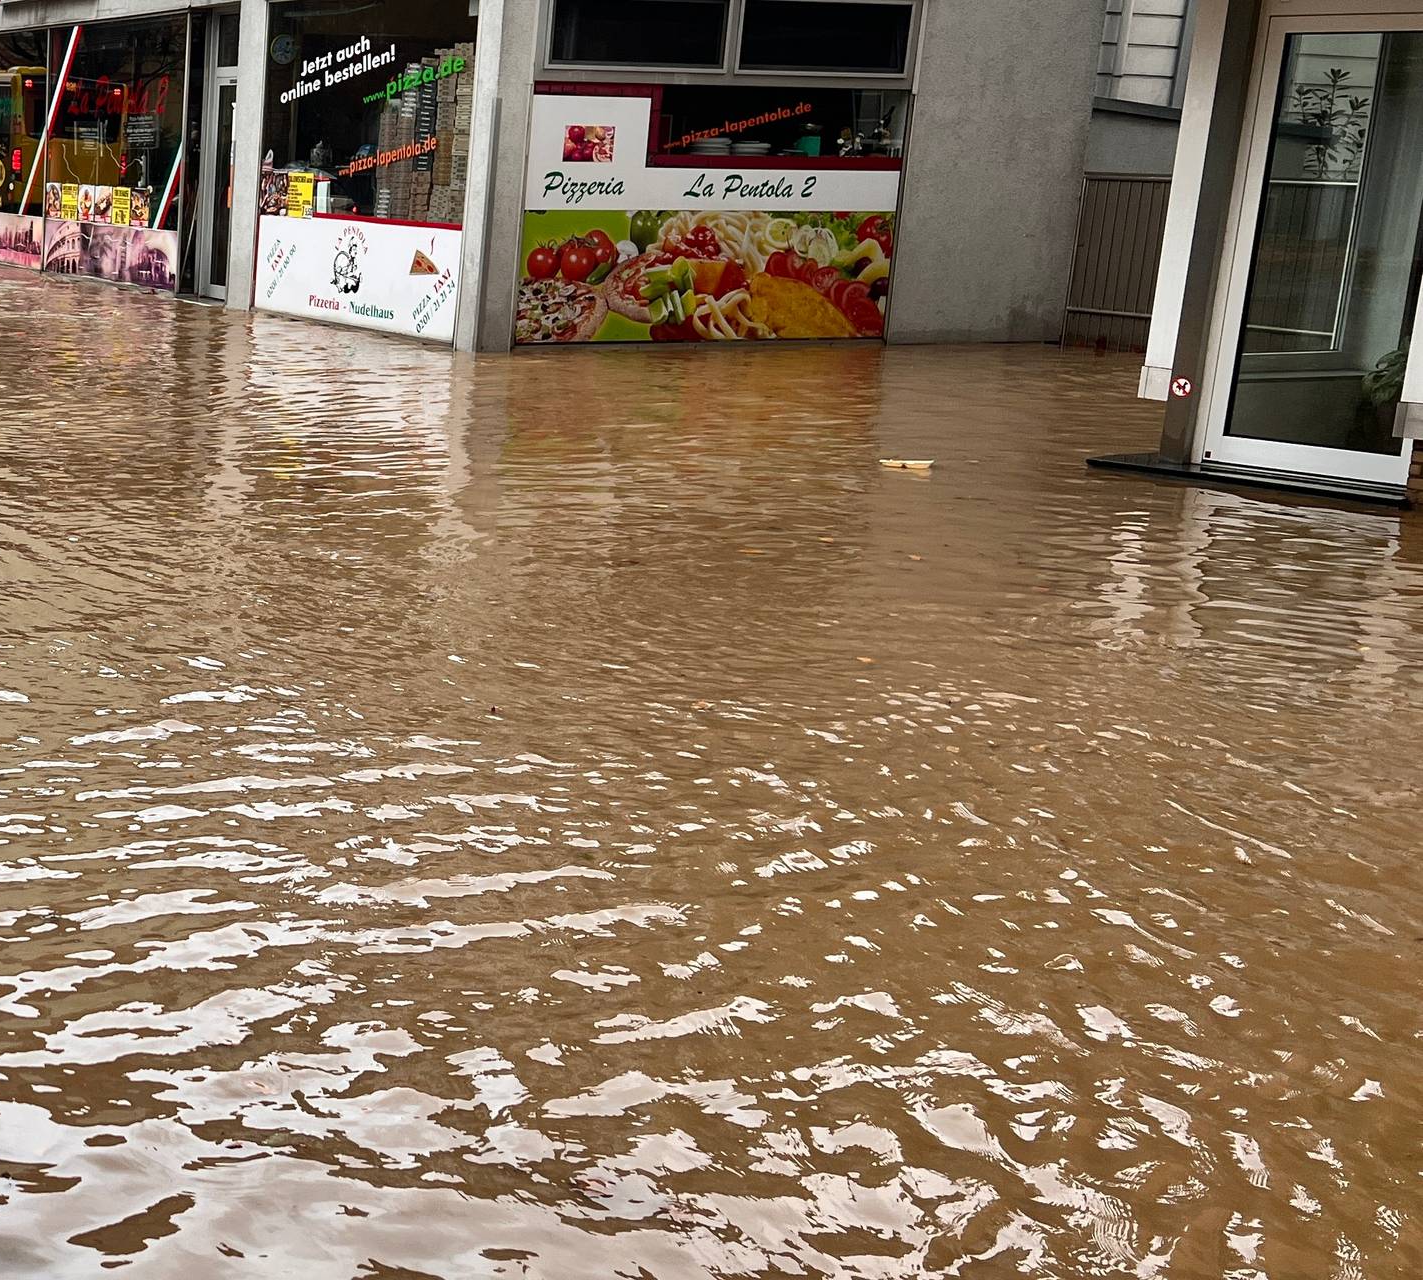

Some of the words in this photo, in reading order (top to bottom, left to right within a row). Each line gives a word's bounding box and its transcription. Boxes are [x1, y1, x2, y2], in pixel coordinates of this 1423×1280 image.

[280, 78, 321, 104] online
[324, 44, 396, 87] bestellen!
[300, 52, 333, 77] Jetzt
[336, 35, 371, 63] auch
[362, 56, 466, 104] www.pizza.de
[663, 102, 812, 149] www.pizza-lapentola.de
[338, 134, 437, 177] www.pizza-lapentola.de
[543, 171, 625, 204] Pizzeria
[683, 173, 715, 199] La
[723, 174, 795, 200] Pentola
[800, 176, 817, 199] 2
[343, 225, 368, 255] PENTOLA
[309, 295, 340, 311] Pizzeria
[349, 301, 395, 320] Nudelhaus
[412, 294, 431, 320] PIZZA
[433, 268, 451, 294] TAXI
